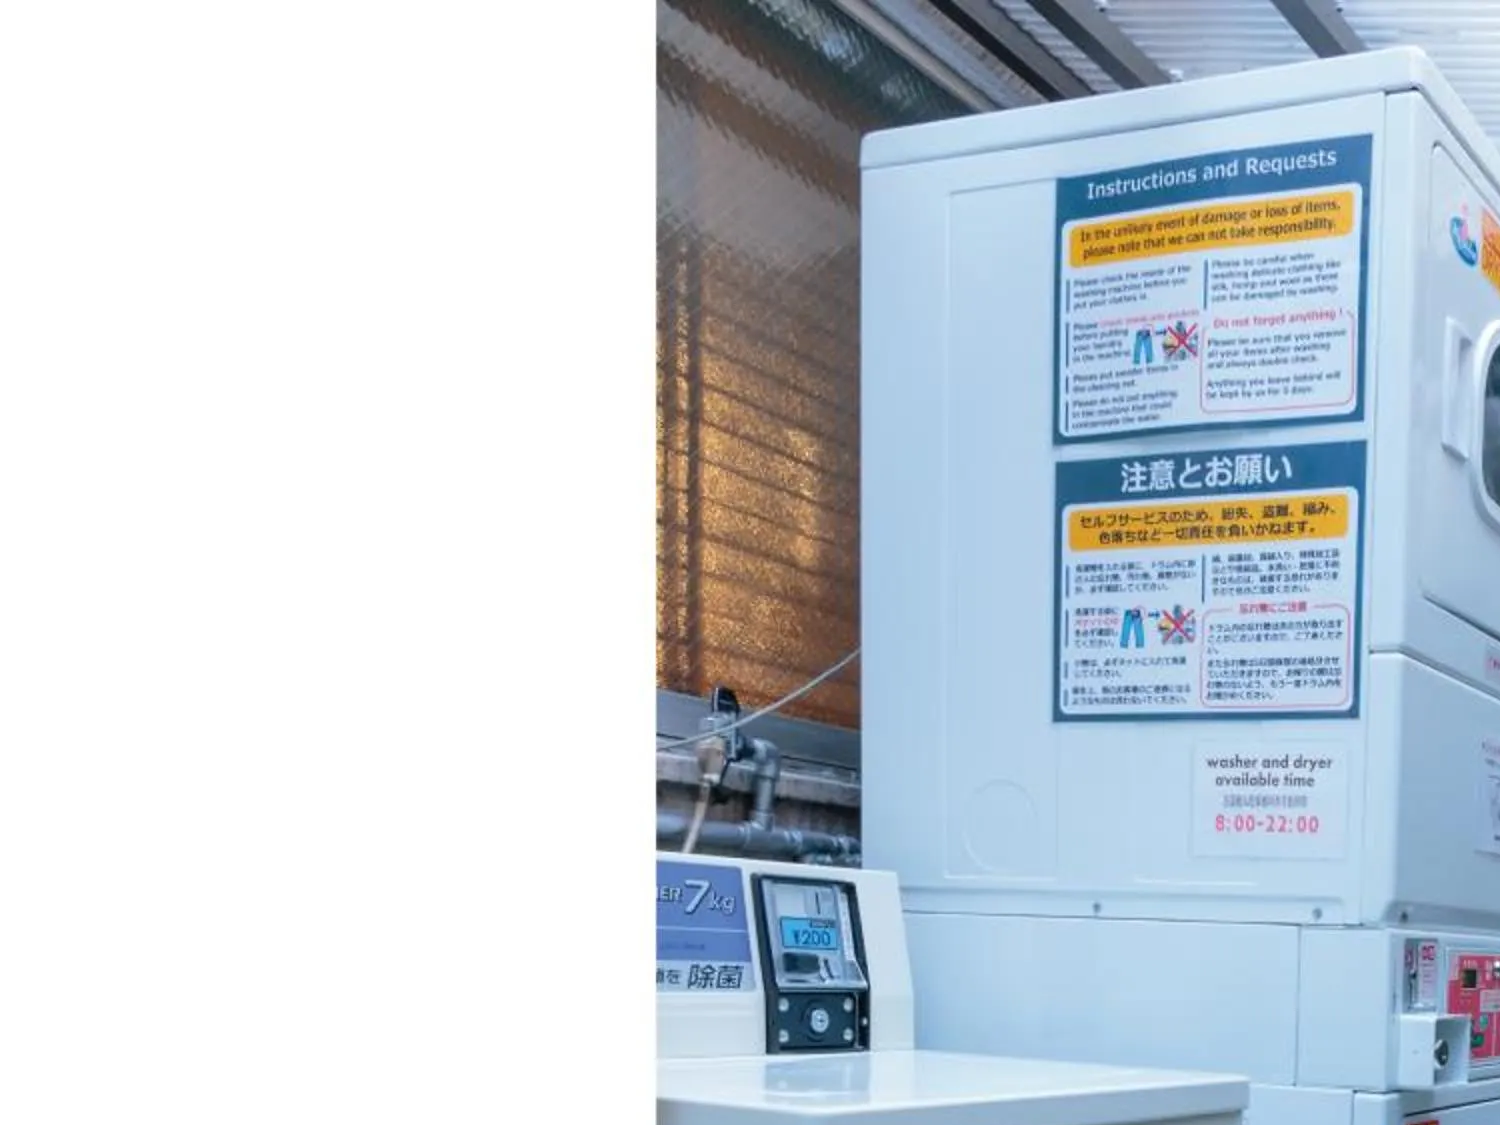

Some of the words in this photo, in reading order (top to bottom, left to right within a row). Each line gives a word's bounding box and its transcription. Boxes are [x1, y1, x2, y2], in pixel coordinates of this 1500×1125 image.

[1087, 169, 1196, 199] Instructions
[1203, 160, 1238, 180] and
[1247, 148, 1337, 176] Requests
[1094, 227, 1110, 240] the
[1156, 217, 1185, 232] event
[1189, 214, 1199, 227] of
[1201, 209, 1246, 228] damage
[1250, 208, 1262, 220] or
[1266, 203, 1288, 218] loss
[1291, 201, 1302, 215] of
[1083, 242, 1115, 260] please
[1118, 239, 1140, 253] note
[1143, 235, 1165, 249] that
[1168, 235, 1182, 245] we
[1185, 231, 1205, 243] can
[1208, 228, 1226, 240] not
[1229, 224, 1254, 238] take
[1257, 216, 1336, 239] responsibility.
[1213, 318, 1228, 330] Do
[1231, 316, 1248, 327] not
[1253, 312, 1284, 327] forget
[1294, 331, 1309, 342] you
[1120, 454, 1292, 493] 注意とお願い
[1207, 754, 1257, 768] washer
[1261, 754, 1289, 768] and
[1293, 754, 1333, 772] dryer
[1215, 772, 1280, 787] available
[1283, 773, 1316, 787] time
[1215, 814, 1320, 833] 8:00-22:00
[656, 886, 683, 903] ER
